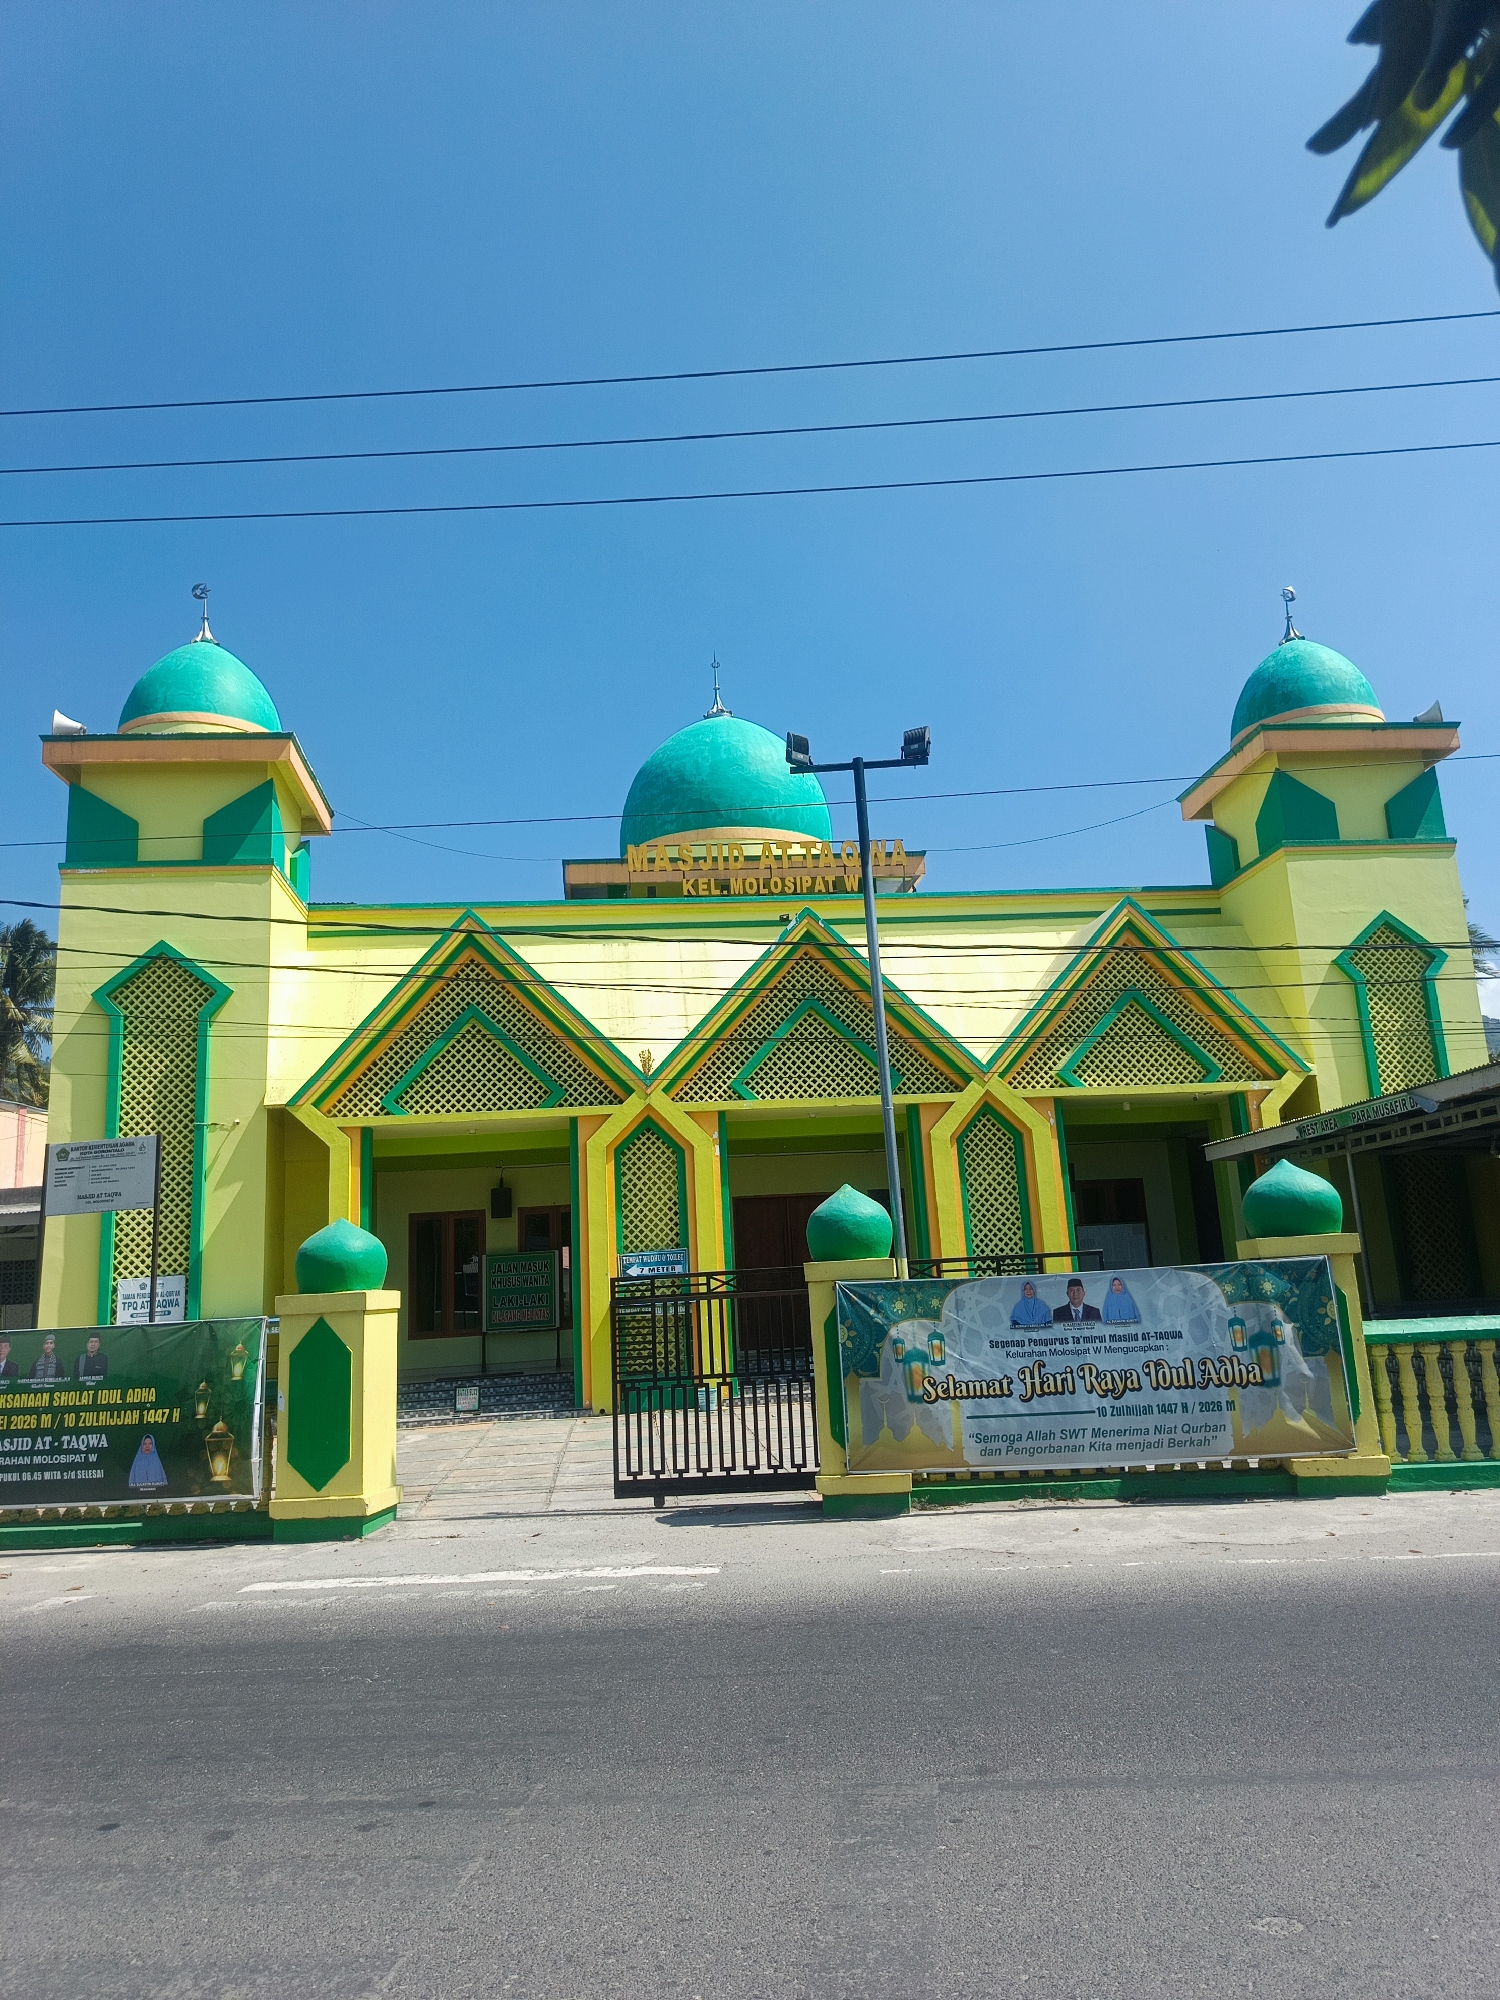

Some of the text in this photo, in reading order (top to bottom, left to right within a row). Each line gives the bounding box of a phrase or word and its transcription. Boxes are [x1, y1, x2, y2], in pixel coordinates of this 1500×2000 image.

[627, 843, 745, 872] MASJID
[844, 873, 859, 892] W
[1321, 1118, 1338, 1132] AREA
[1351, 1110, 1372, 1123] PARA
[1372, 1097, 1409, 1118] MUSAFIR
[104, 1191, 122, 1199] TAQWA
[491, 1260, 550, 1275] JALAN MASUK
[622, 1256, 642, 1264] TEMPAT
[667, 1253, 684, 1261] TOILET
[491, 1274, 550, 1289] KHUSUS WANITA
[122, 1298, 180, 1311] TPQ AT AQWA
[493, 1293, 549, 1308] LAKI-LAKI
[492, 1308, 550, 1323] DILARANG MELINTAS
[989, 1330, 1183, 1349] Segenap Pengurus Ta'mirul Masjid AT-TAQWA
[1005, 1349, 1047, 1359] Kelurahan
[1049, 1347, 1091, 1357] Molosipat
[1092, 1346, 1102, 1354] W
[1104, 1343, 1165, 1354] Mengucapkan
[922, 1354, 1265, 1404] Selamat Hari Raya Idul Adha
[53, 1390, 94, 1407] SHOLAT
[97, 1389, 123, 1404] IDUL
[126, 1387, 156, 1403] ADHA
[1096, 1406, 1107, 1418] 10
[1110, 1403, 1154, 1417] Zulhijjah
[1156, 1402, 1178, 1415] 1447
[1181, 1402, 1188, 1414] H
[1199, 1400, 1222, 1413] 2026
[1226, 1400, 1236, 1411] M
[10, 1414, 38, 1430] 2026
[40, 1413, 52, 1429] M
[53, 1412, 61, 1430] /
[64, 1412, 76, 1428] 10
[78, 1409, 140, 1427] ZULHIJJAH
[142, 1408, 170, 1424] 1447
[172, 1407, 181, 1423] H
[1025, 1429, 1056, 1441] Allah
[1060, 1427, 1088, 1440] SWT
[1091, 1425, 1150, 1438] Menerima
[1154, 1423, 1178, 1436] Niat
[1181, 1422, 1226, 1434] Qurban
[34, 1436, 52, 1450] AT
[61, 1433, 108, 1451] TAQWA
[980, 1446, 1002, 1457] dan
[1005, 1443, 1085, 1457] Pengorbanan
[1089, 1441, 1112, 1452] Kita
[1116, 1438, 1164, 1452] menjadi
[33, 1454, 86, 1464] MOLOSIPAT
[88, 1453, 98, 1462] W
[0, 1469, 104, 1482] PUKUL 06.45 WITA s/d SELESAI
